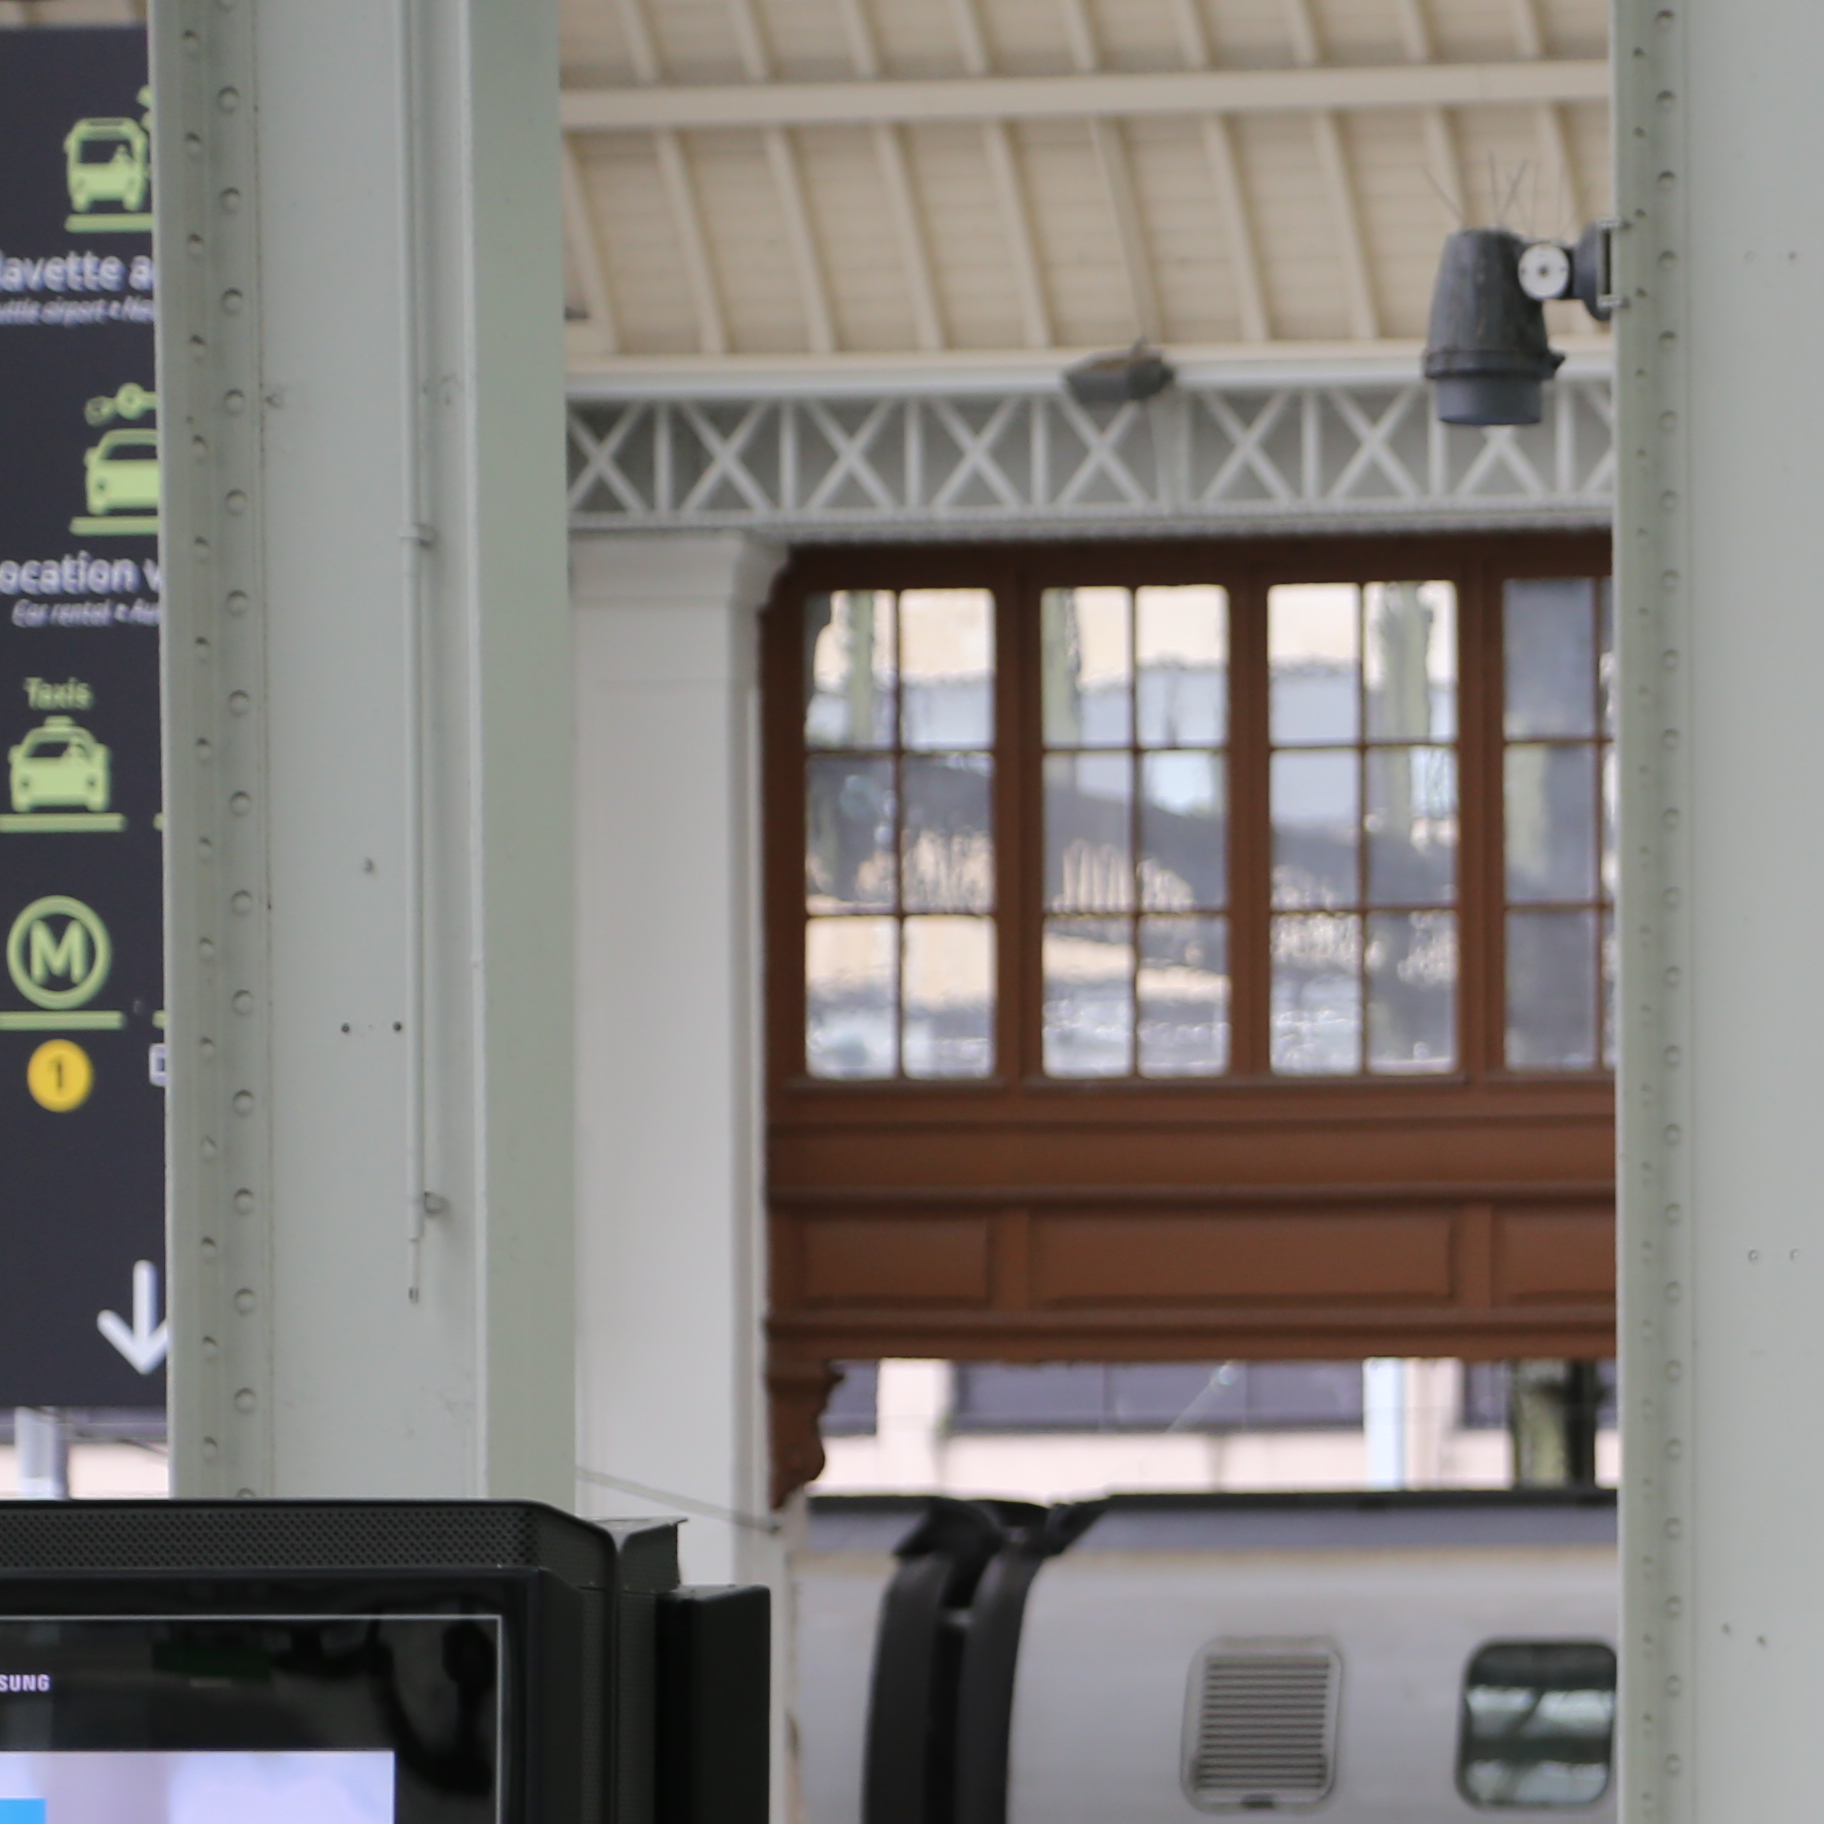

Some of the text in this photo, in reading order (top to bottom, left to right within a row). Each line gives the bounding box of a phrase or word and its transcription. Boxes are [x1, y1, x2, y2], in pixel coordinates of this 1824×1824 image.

[0, 250, 125, 292] avette
[11, 599, 49, 628] Car
[50, 599, 113, 628] rental
[24, 676, 94, 711] Taxis
[30, 919, 88, 985] M
[0, 1673, 51, 1692] SUNG
